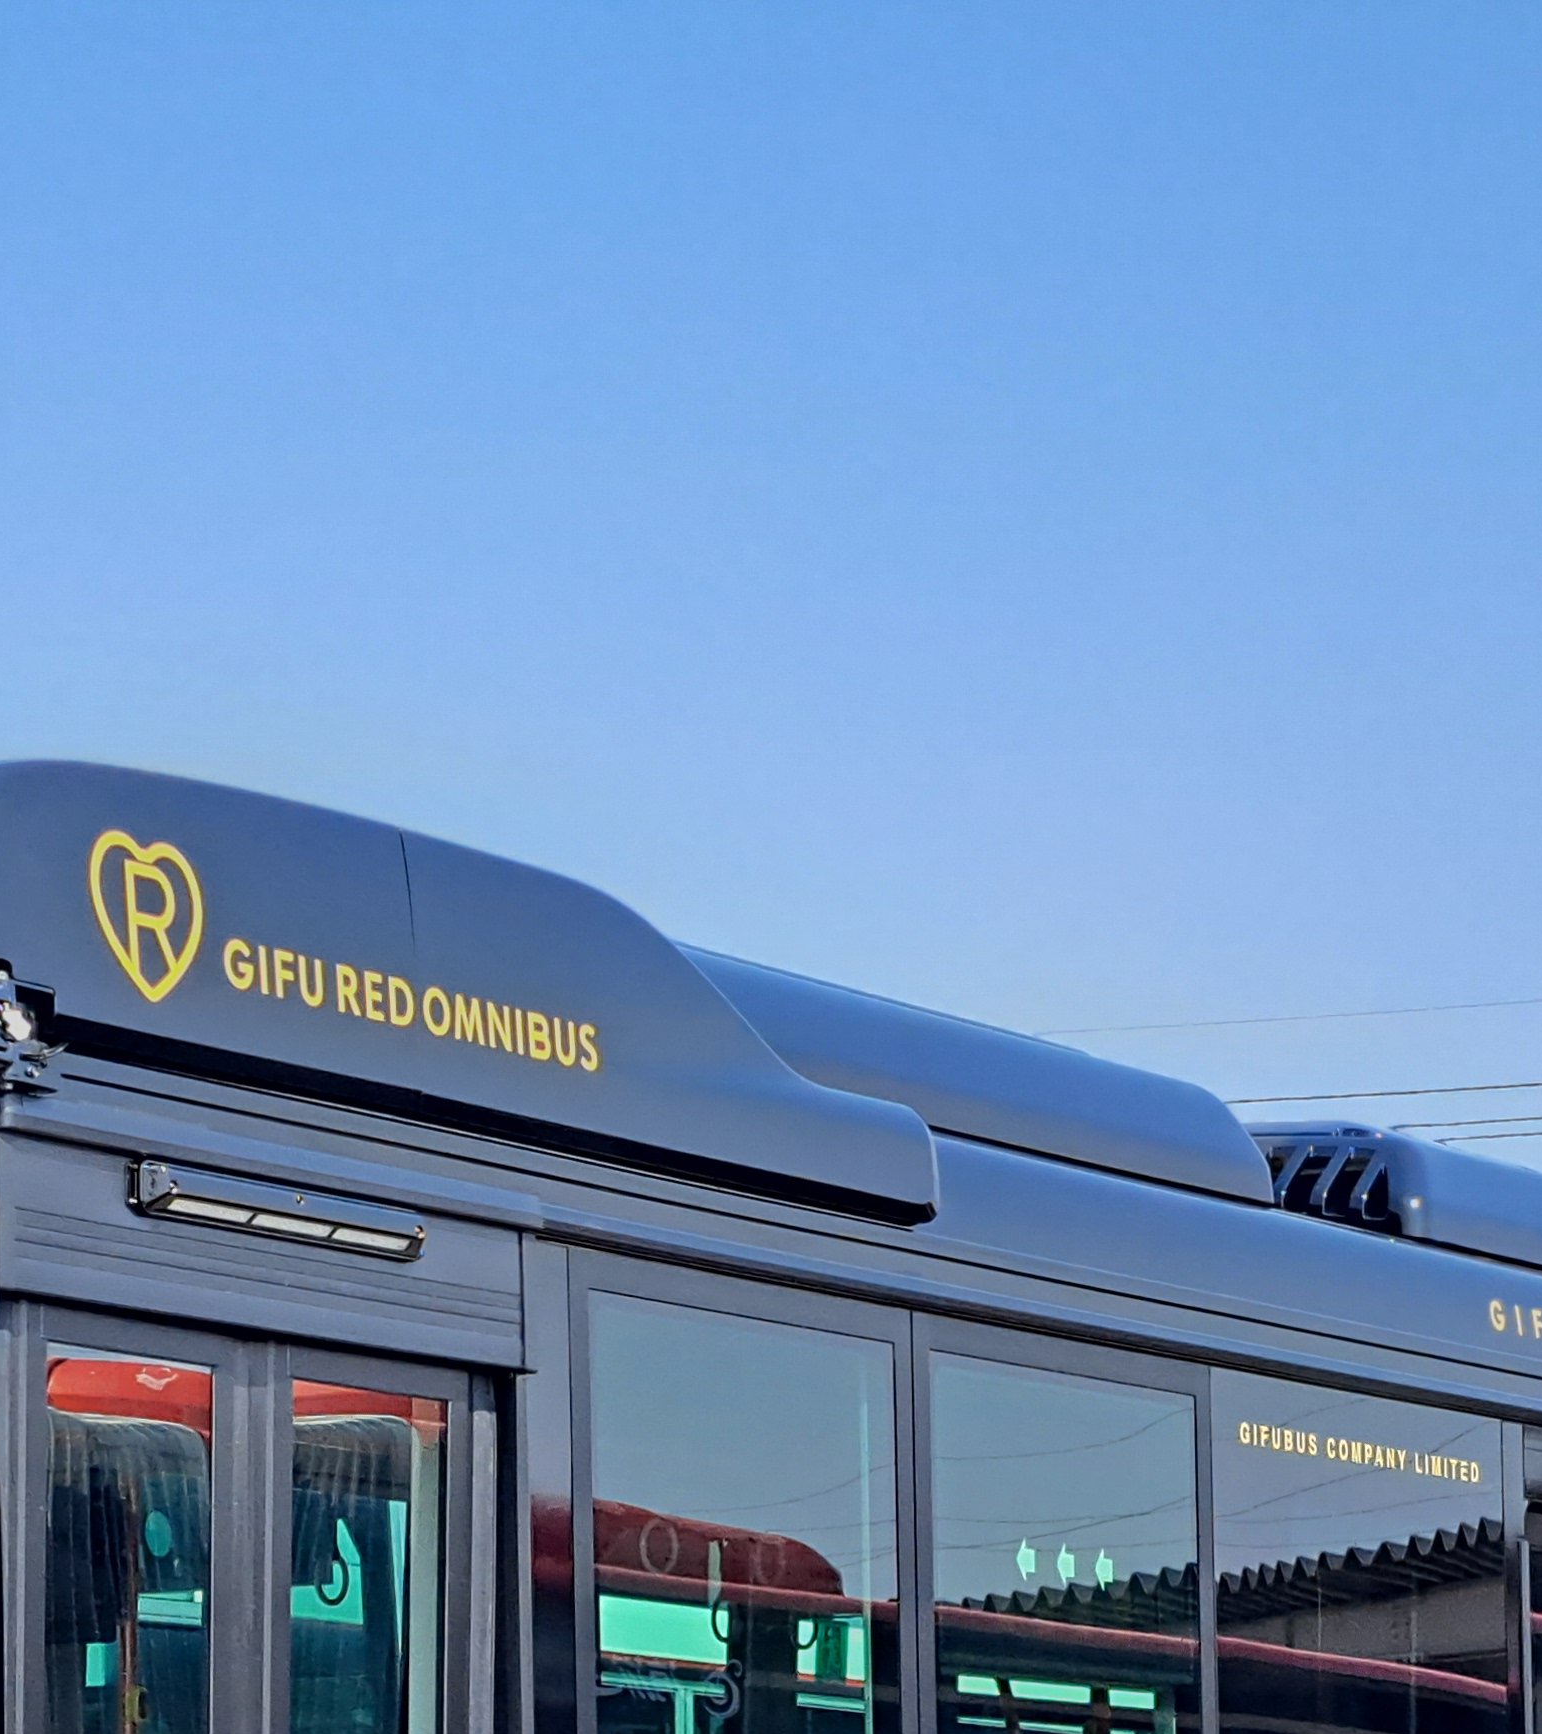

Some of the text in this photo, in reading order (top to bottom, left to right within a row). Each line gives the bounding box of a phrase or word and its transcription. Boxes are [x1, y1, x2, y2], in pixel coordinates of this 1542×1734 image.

[223, 937, 600, 1072] GIFU RED OMNIBUS
[1238, 1420, 1482, 1484] GIFUBUS COMPANY LIMITED
